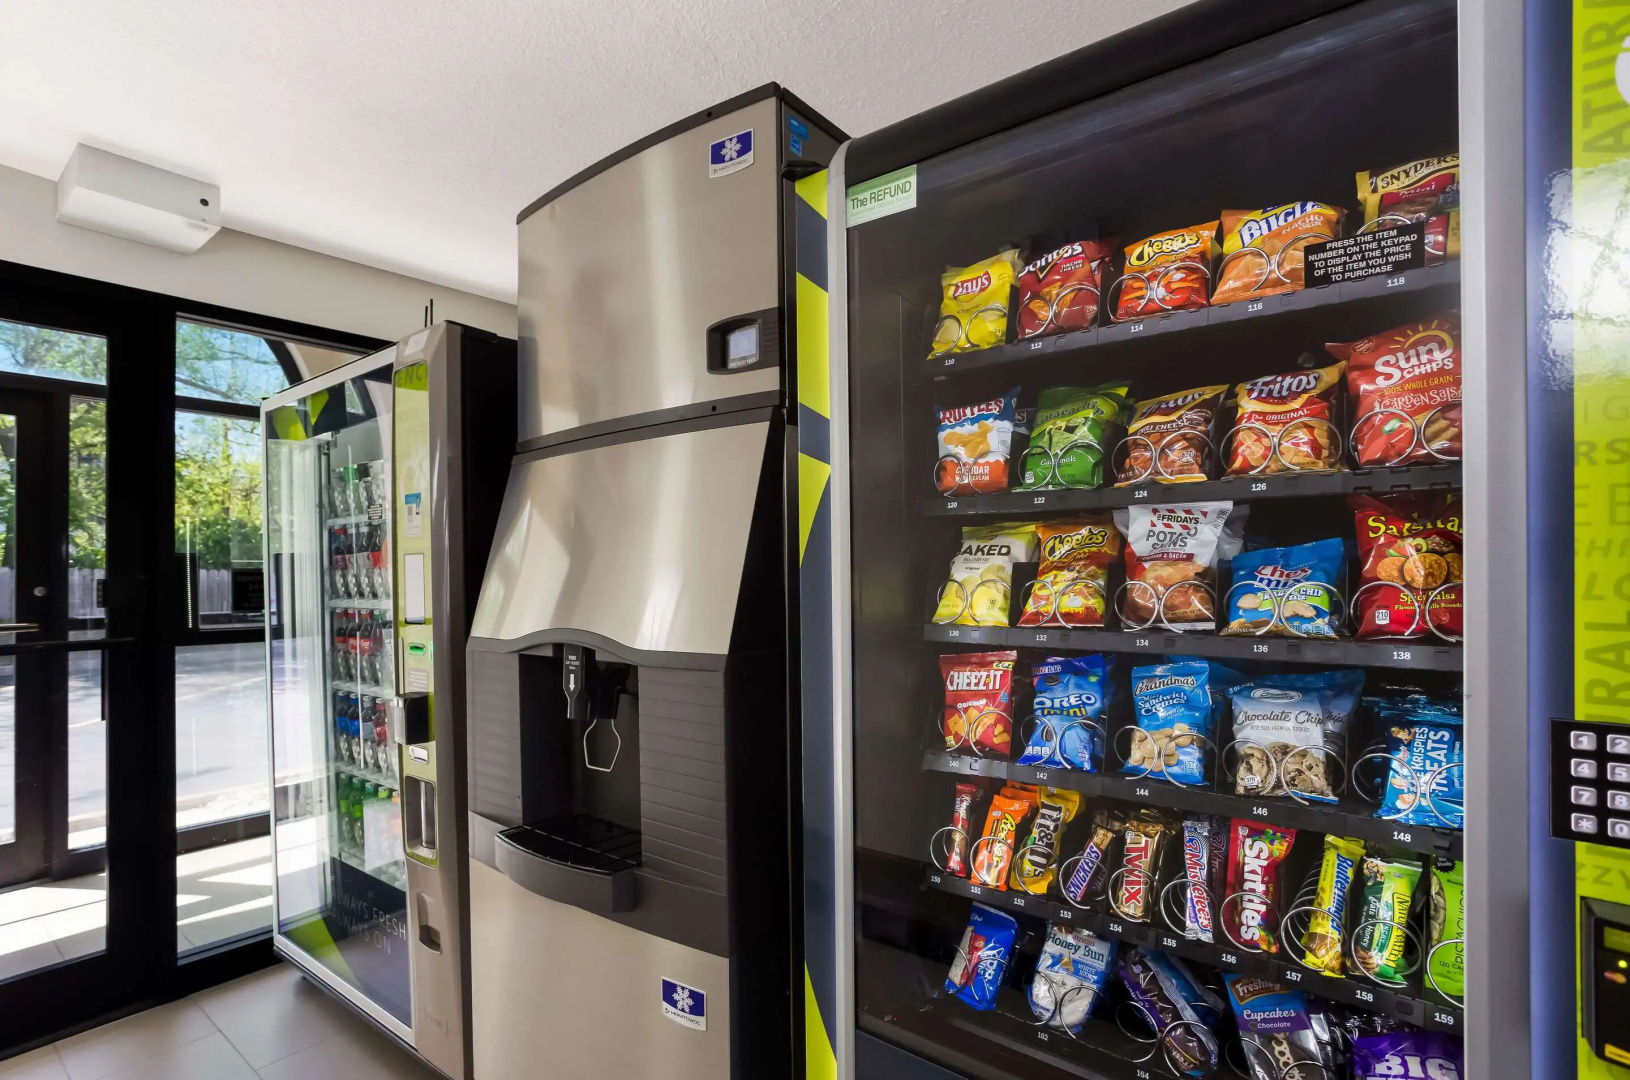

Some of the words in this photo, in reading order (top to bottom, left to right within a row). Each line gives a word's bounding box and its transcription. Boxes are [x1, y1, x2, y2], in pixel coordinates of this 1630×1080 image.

[850, 196, 868, 210] The
[869, 180, 912, 205] REFUND
[1281, 214, 1323, 234] NACHO
[1326, 237, 1357, 250] PRESS
[1359, 233, 1374, 245] THE
[1376, 229, 1397, 241] ITEM
[1130, 233, 1199, 266] Cheetos
[1308, 248, 1344, 262] NUMBER
[1346, 245, 1359, 256] ON
[1360, 241, 1379, 252] THE
[1380, 233, 1417, 249] KEYPAD
[1314, 260, 1326, 269] TO
[1327, 253, 1364, 268] DISPLAY
[1365, 249, 1382, 261] THE
[1383, 243, 1411, 257] PRICE
[1060, 264, 1083, 273] CHEESE
[1061, 260, 1083, 269] NACHO
[1314, 268, 1326, 278] OF
[1327, 264, 1344, 275] THE
[1345, 260, 1366, 272] ITEM
[1367, 256, 1386, 267] YOU
[1387, 252, 1411, 265] WISH
[1330, 273, 1343, 282] TO
[1344, 264, 1393, 280] PURCHASE
[1386, 277, 1405, 287] 118
[1247, 302, 1263, 311] 116
[1375, 342, 1450, 387] Sun
[1403, 358, 1454, 378] CHIPS
[1245, 372, 1319, 401] Fritos
[1383, 387, 1402, 396] 100%
[1403, 381, 1428, 391] WHOLE
[1429, 375, 1453, 386] GRAIN
[1265, 408, 1310, 421] ORIGINAL
[1155, 416, 1190, 431] CHEESE
[1251, 483, 1267, 491] 126
[1134, 490, 1148, 498] 124
[1161, 514, 1200, 524] FRIDAYS
[957, 544, 1011, 556] AKED
[1044, 528, 1108, 562] Cheetos
[1254, 565, 1313, 579] Chex
[1299, 588, 1323, 598] CHIP
[1399, 591, 1427, 605] Spicy
[1428, 591, 1456, 601] Salsa
[1376, 611, 1389, 619] 210
[1135, 639, 1149, 647] 134
[1252, 645, 1268, 653] 136
[1393, 651, 1411, 660] 138
[1134, 674, 1196, 697] Grandma's
[1034, 693, 1096, 710] OREO
[1138, 691, 1188, 709] Sandwich
[1043, 704, 1087, 717] mini
[1235, 710, 1293, 726] Chocolate
[1295, 710, 1326, 727] Chip
[1578, 735, 1588, 747] 1
[1613, 738, 1628, 751] 2
[1410, 726, 1429, 770] KRISPIES
[948, 760, 959, 768] 140
[1426, 730, 1450, 792] TREATS
[1036, 771, 1048, 780] 142
[1576, 763, 1590, 775] 4
[1614, 766, 1628, 779] 5
[1135, 788, 1149, 797] 144
[1578, 790, 1591, 802] 7
[1614, 794, 1628, 807] 8
[1252, 806, 1267, 816] 146
[1614, 822, 1628, 836] 0
[1392, 831, 1411, 843] 148
[1066, 842, 1102, 901] SNICKERS
[1240, 837, 1270, 942] Skittles
[1326, 852, 1354, 936] Butterfinger
[1013, 897, 1025, 906] 152
[1368, 898, 1380, 916] Oats
[1060, 910, 1072, 919] 153
[372, 907, 407, 942] FRESH
[1109, 923, 1123, 933] 154
[373, 930, 391, 956] ON
[1073, 935, 1095, 947] JUMBO
[1162, 937, 1177, 948] 155
[1361, 924, 1374, 949] Honey
[1046, 933, 1082, 955] Honey
[1082, 945, 1106, 964] Bun
[1221, 953, 1237, 964] 156
[1285, 971, 1302, 982] 157
[1355, 989, 1374, 1002] 158
[670, 1009, 702, 1026] MANITOWOC
[1243, 1007, 1297, 1023] Cupcakes
[1433, 1011, 1454, 1025] 159
[1257, 1022, 1291, 1030] Chocolate
[1037, 1031, 1049, 1041] 162
[1375, 1054, 1460, 1080] BIG
